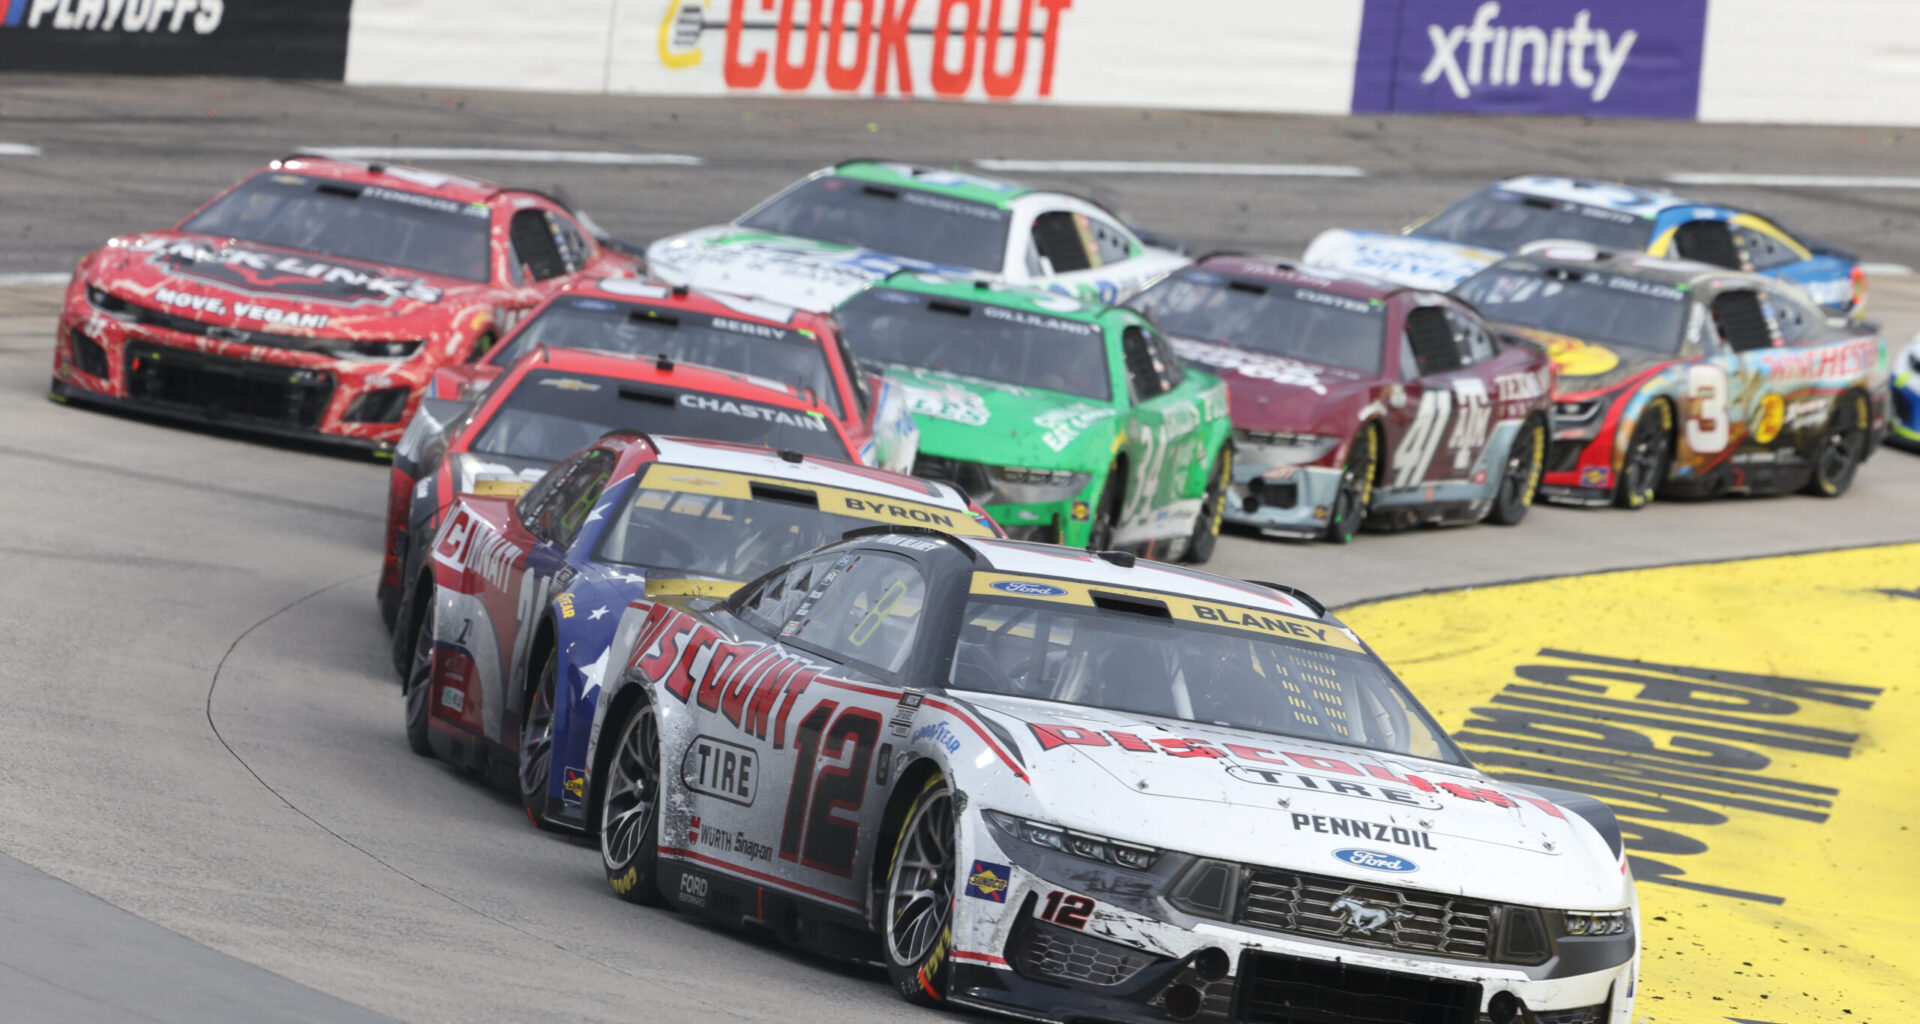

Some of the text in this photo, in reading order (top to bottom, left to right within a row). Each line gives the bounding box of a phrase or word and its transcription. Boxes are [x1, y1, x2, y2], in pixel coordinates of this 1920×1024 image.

[26, 0, 226, 35] PLAYOFFS
[722, 0, 1075, 98] COOK OUT
[1420, 1, 1639, 103] xfinity
[232, 301, 329, 329] VEGAN!
[711, 316, 787, 341] BERRY
[983, 306, 1091, 337] GILLILAND
[678, 393, 829, 433] CHASTAIN
[1685, 364, 1730, 454] 3
[1393, 389, 1452, 488] 41
[845, 497, 955, 529] BYRON
[1192, 604, 1330, 643] BLANEY
[626, 601, 832, 751] DISCOUNT
[698, 743, 753, 798] TIRE
[776, 698, 884, 880] 12
[1025, 722, 1569, 822] DISCOUNT
[1245, 767, 1421, 806] TIRE
[1291, 812, 1439, 851] PENNZOIL
[1349, 850, 1404, 871] Ford
[681, 872, 708, 897] FORD
[1041, 889, 1096, 930] 12
